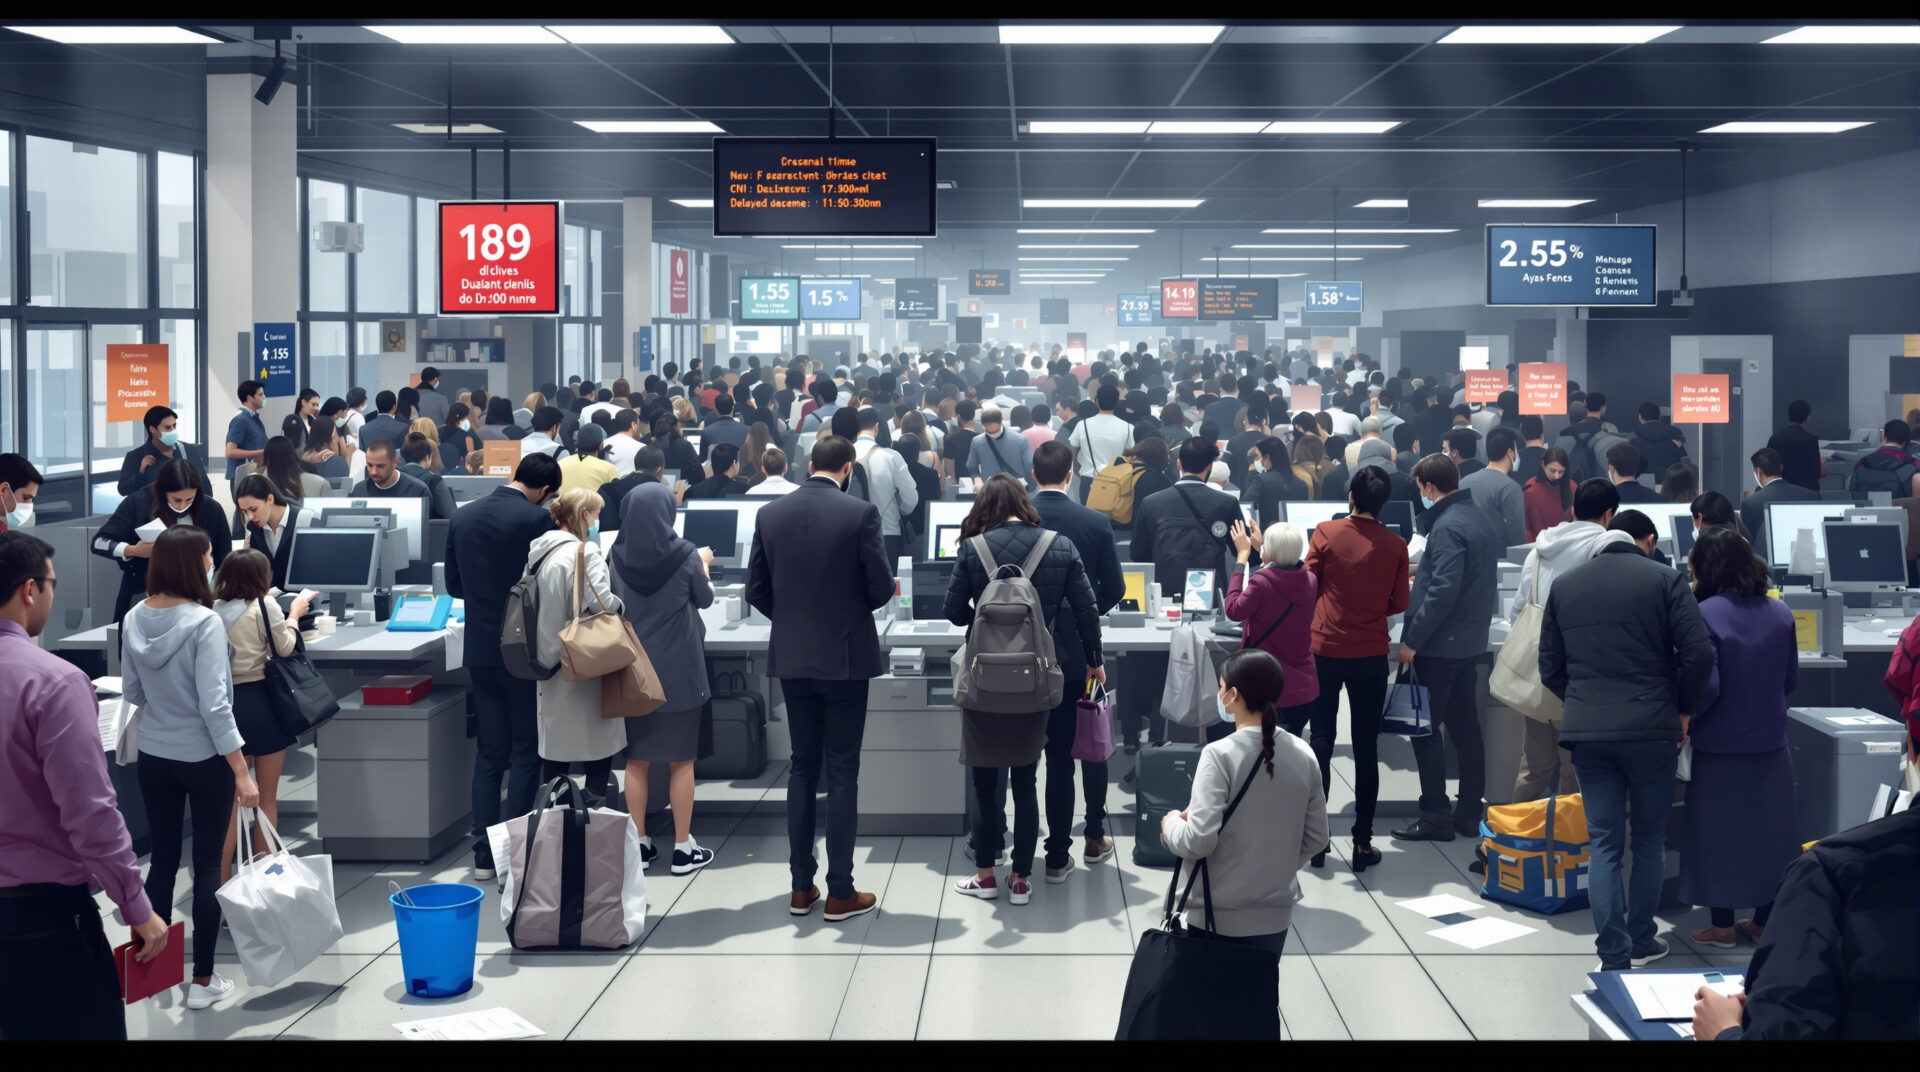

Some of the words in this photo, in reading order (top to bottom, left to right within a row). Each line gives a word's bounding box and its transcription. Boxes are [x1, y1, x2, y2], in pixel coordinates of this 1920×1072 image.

[730, 198, 768, 209] Delayed
[459, 223, 531, 261] 189
[459, 293, 473, 304] do
[749, 283, 790, 300] 1.55
